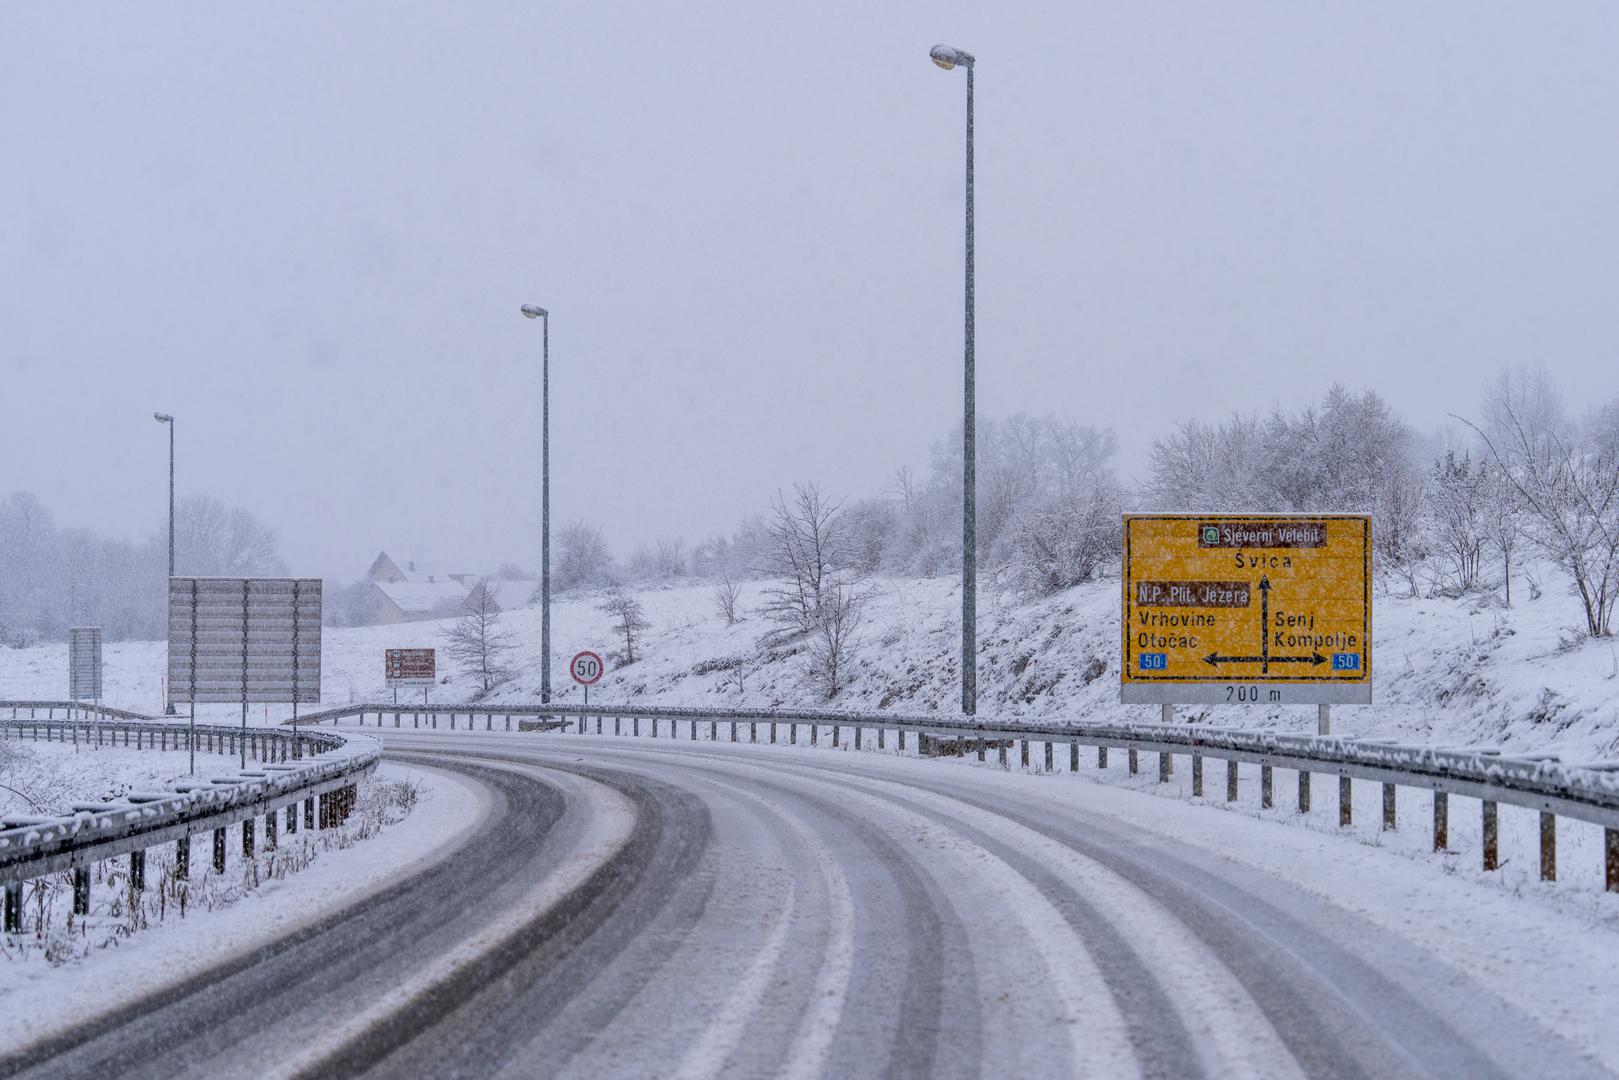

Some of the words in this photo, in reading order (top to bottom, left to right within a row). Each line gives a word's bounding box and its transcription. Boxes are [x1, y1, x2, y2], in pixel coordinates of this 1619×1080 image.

[1223, 527, 1273, 544] Sjeverni
[1278, 527, 1320, 543] Velebit
[1235, 549, 1292, 569] Švica
[1139, 585, 1166, 603] N.P.
[1170, 585, 1196, 603] Plit.
[1201, 586, 1249, 604] Jezera
[1138, 611, 1216, 627] Vrhovine
[1275, 612, 1315, 628] Senj
[1138, 632, 1199, 648] Otočac
[1275, 632, 1357, 652] Kompolje
[577, 660, 596, 676] 50
[1144, 654, 1161, 668] 50
[1337, 654, 1354, 668] 50
[1269, 689, 1281, 702] m
